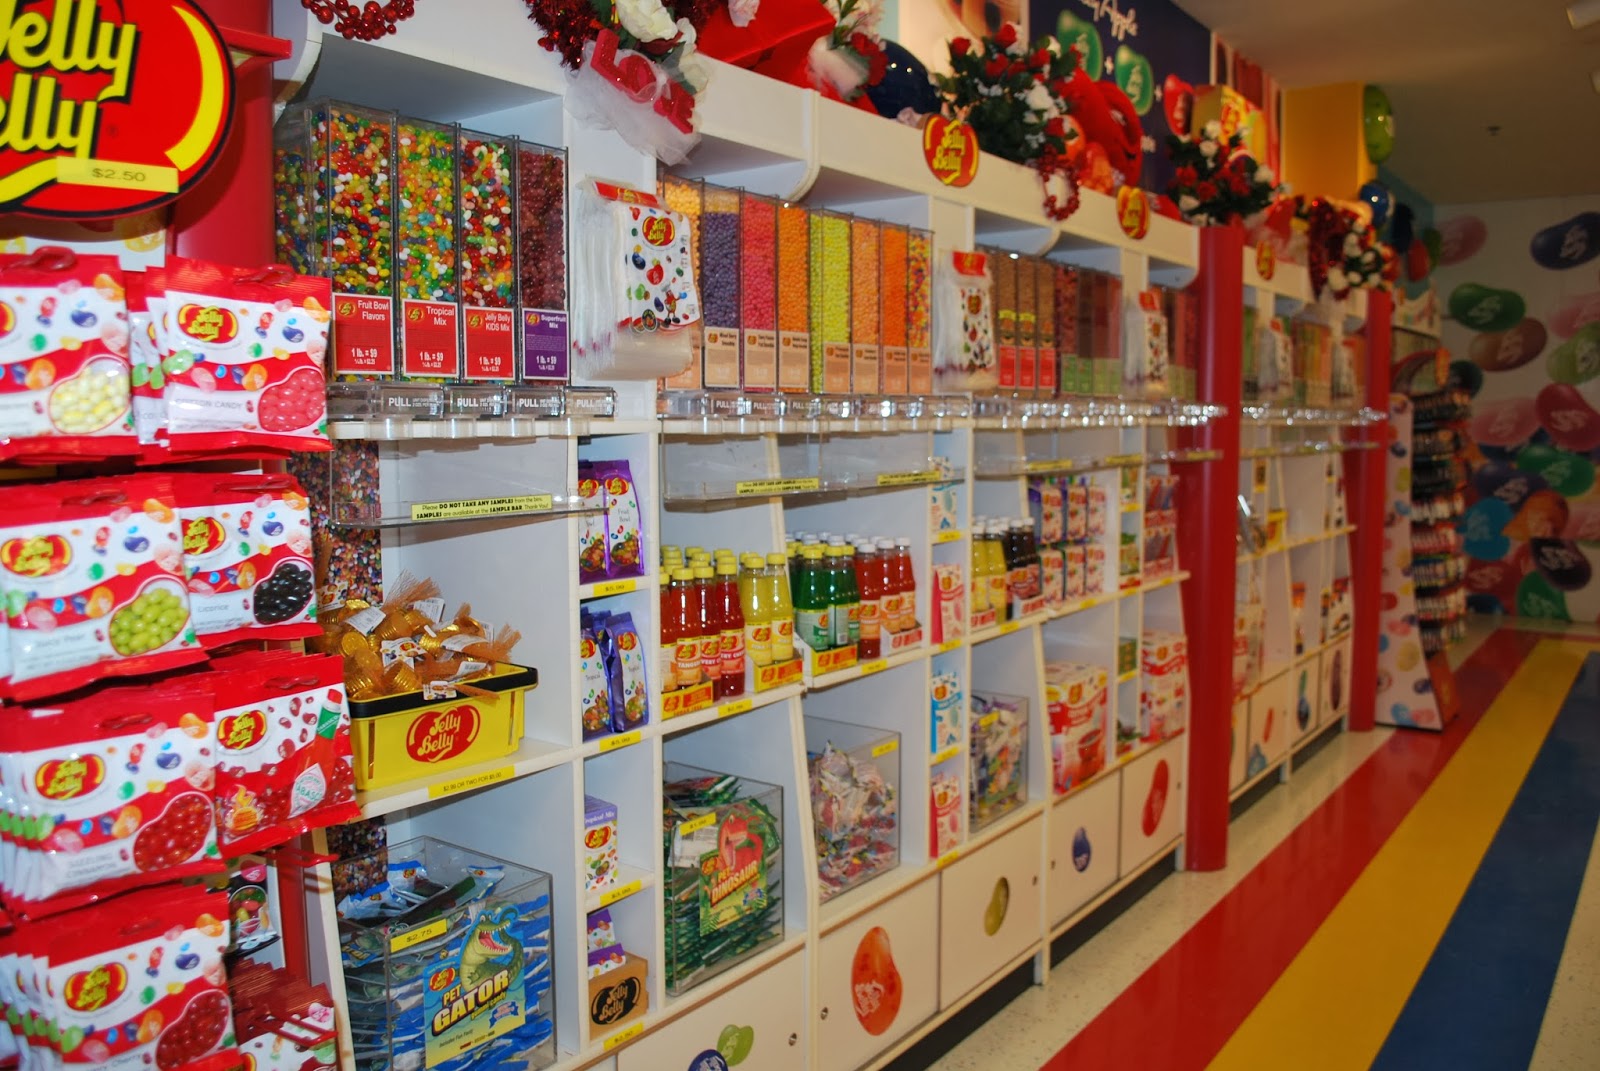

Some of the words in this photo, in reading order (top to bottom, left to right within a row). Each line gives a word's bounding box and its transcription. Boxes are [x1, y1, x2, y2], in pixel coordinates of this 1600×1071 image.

[0, 0, 138, 103] elly
[941, 119, 966, 157] Jelly
[933, 146, 961, 185] Belly
[92, 166, 147, 182] $2.50
[357, 300, 373, 309] Fruit
[374, 301, 389, 310] Bowl
[426, 306, 455, 316] Tropical
[362, 311, 386, 321] Flavors
[433, 317, 447, 326] Mix
[498, 314, 511, 323] Belly
[541, 315, 567, 323] Superfruit
[486, 323, 499, 331] KIDS
[500, 323, 510, 332] Mix
[214, 401, 242, 409] CANDY
[388, 397, 411, 407] PULL
[457, 398, 478, 407] PULL
[519, 398, 539, 407] PULL
[716, 400, 730, 409] PULL
[490, 505, 510, 513] SAMPLE
[232, 711, 255, 732] Jelly
[429, 706, 461, 736] Jelly
[226, 730, 252, 750] Belly
[417, 733, 454, 763] Belly
[478, 775, 488, 783] FOR
[711, 860, 758, 907] DINOSAUR
[406, 928, 432, 943] $2.75
[443, 984, 462, 1007] PET
[607, 979, 629, 1004] Jelly
[432, 968, 510, 1036] GATOR
[599, 999, 625, 1024] Belly
